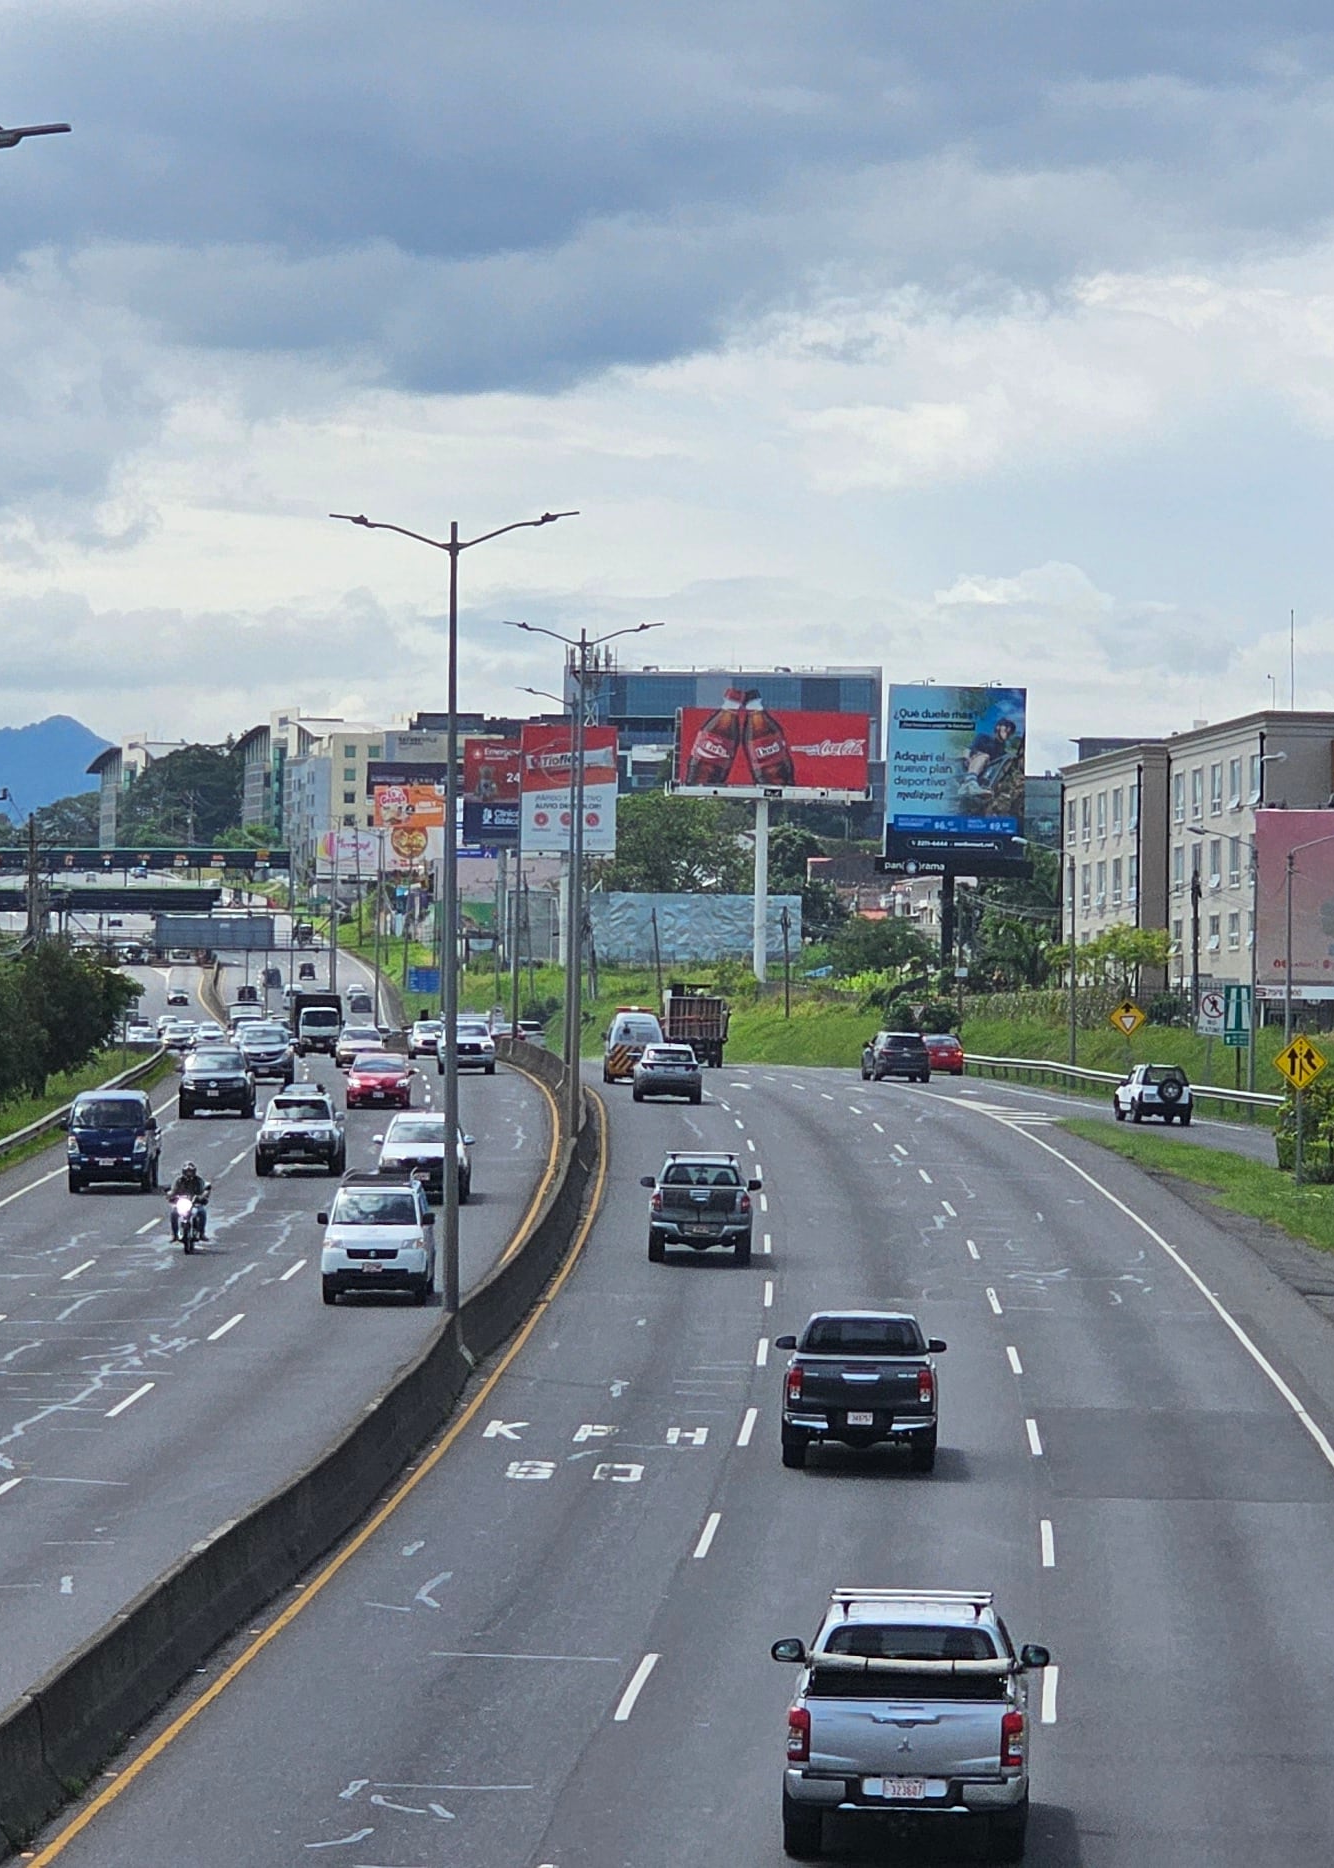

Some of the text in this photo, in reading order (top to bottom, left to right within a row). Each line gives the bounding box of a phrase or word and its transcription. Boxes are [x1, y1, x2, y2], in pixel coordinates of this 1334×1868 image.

[893, 764, 953, 775] nuevo plan
[506, 772, 520, 783] 24
[894, 776, 947, 787] deportivo
